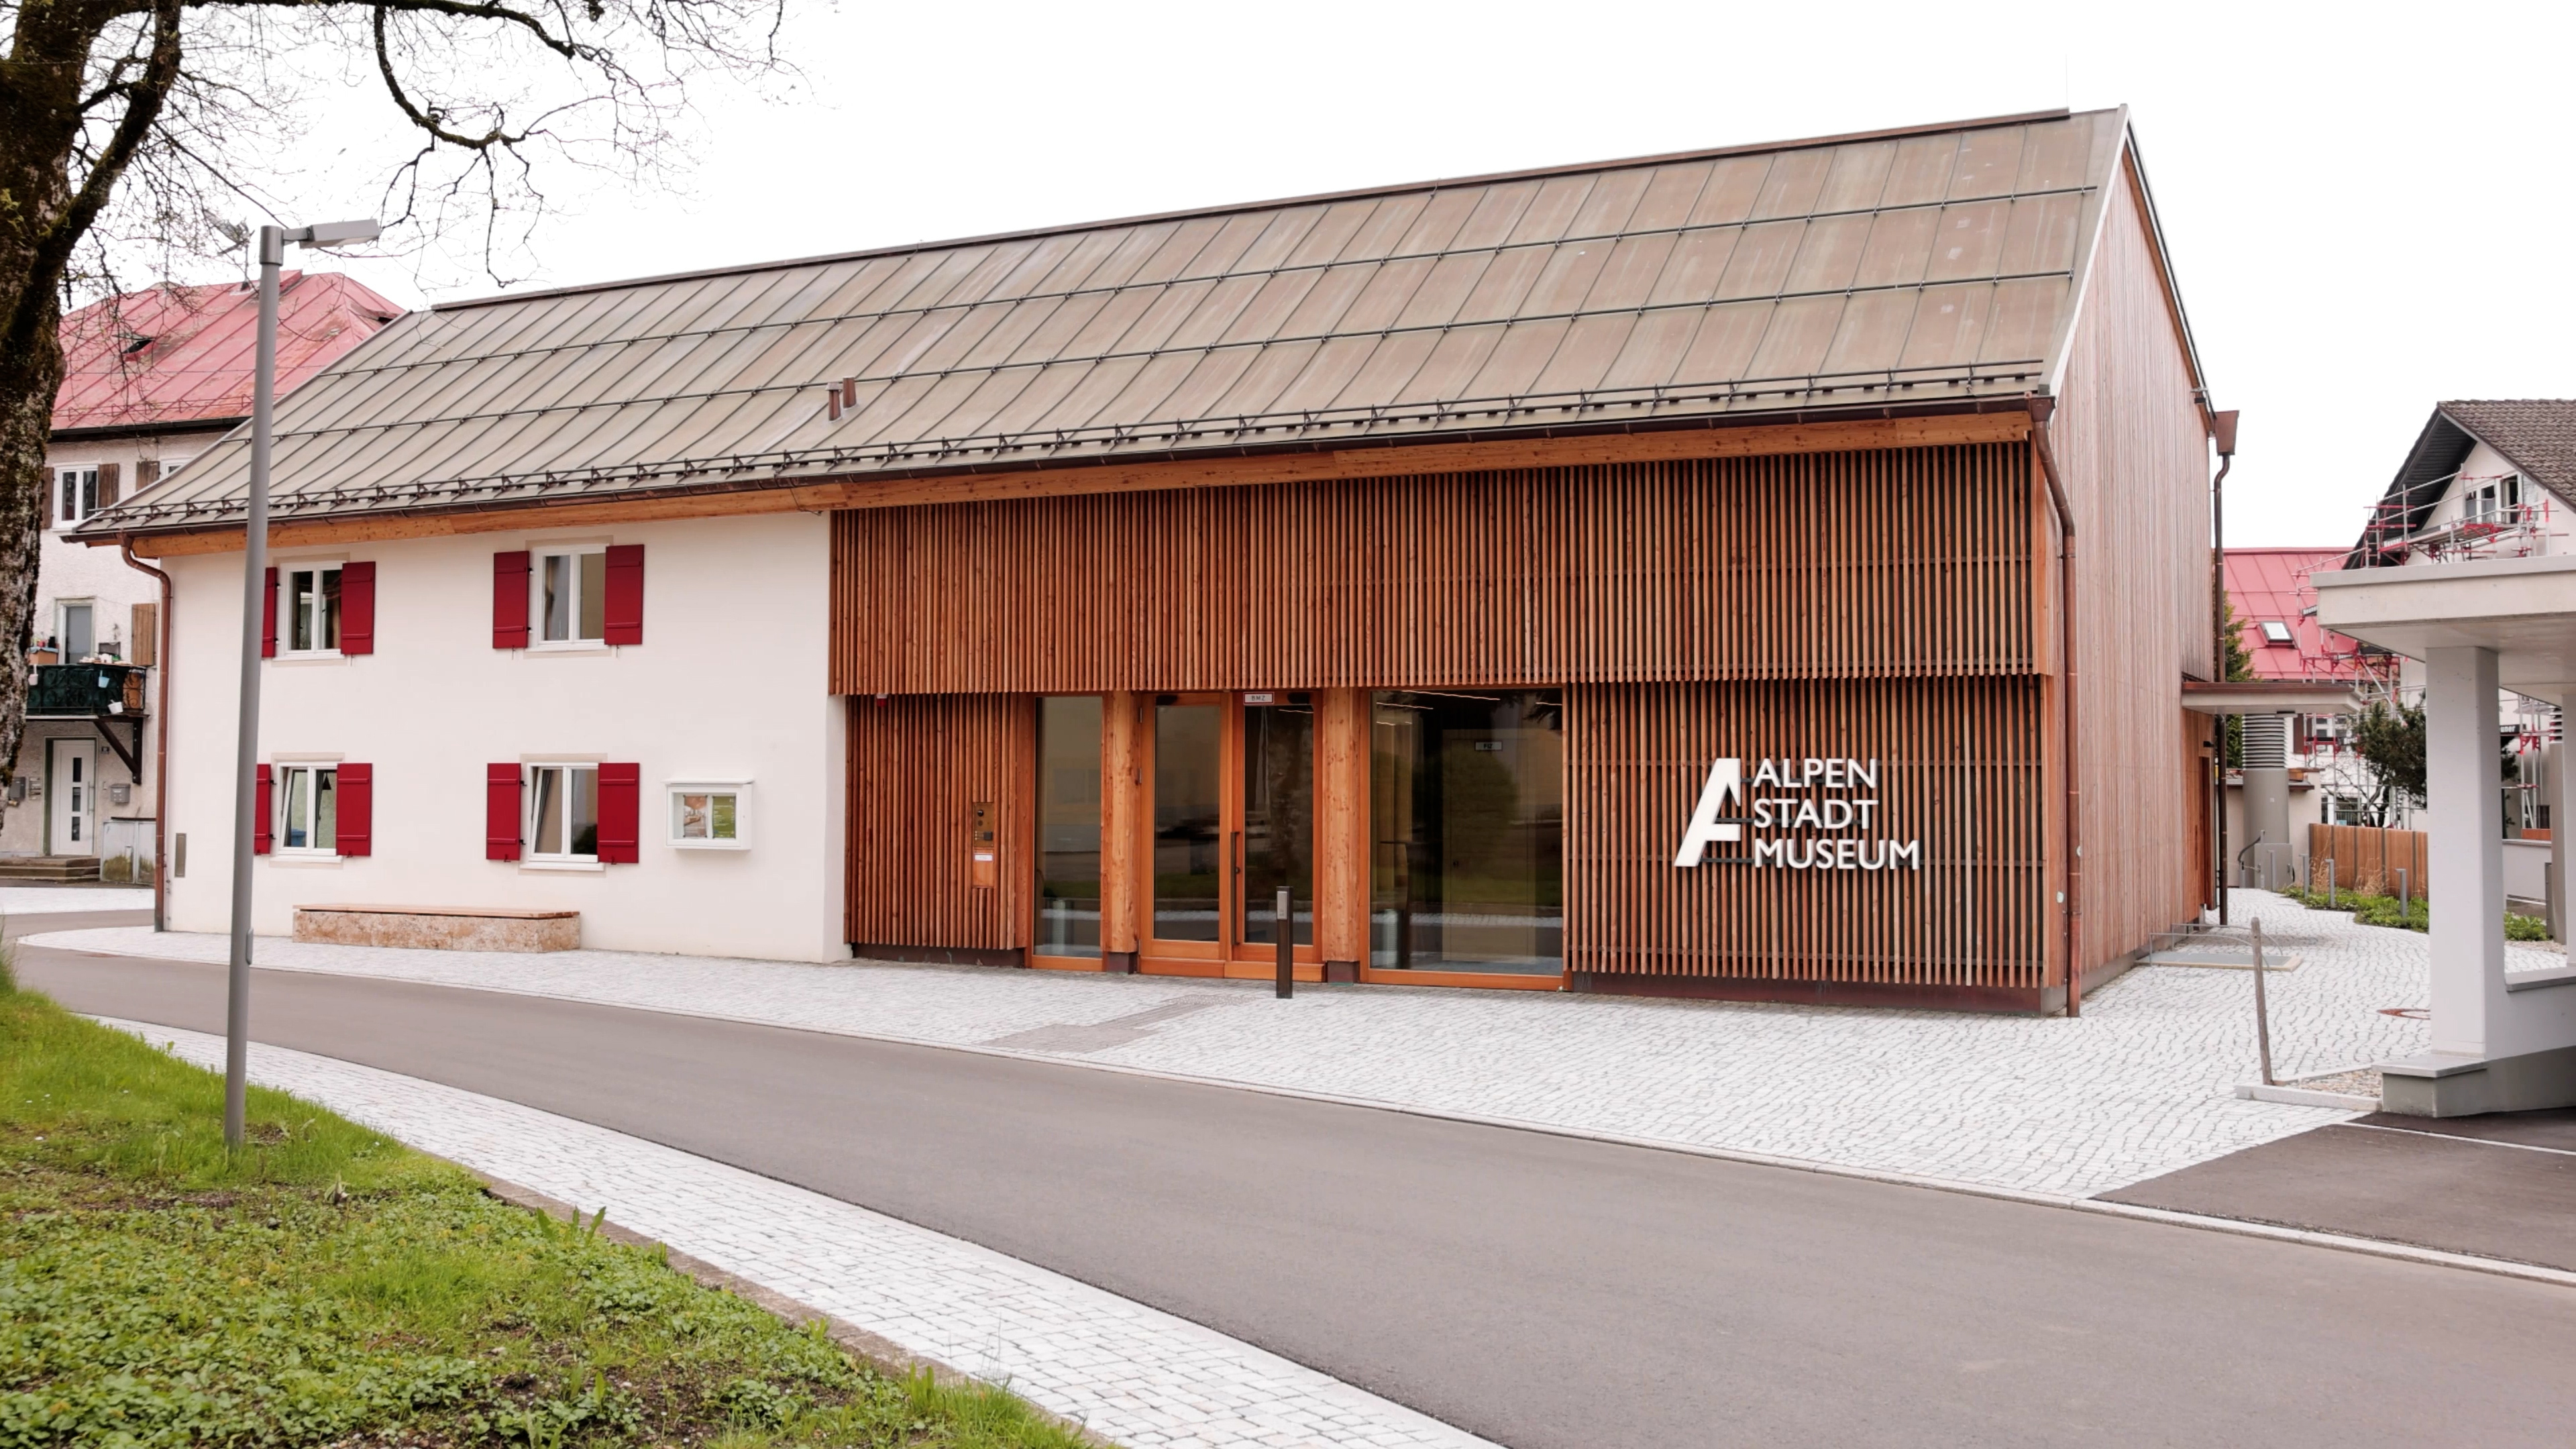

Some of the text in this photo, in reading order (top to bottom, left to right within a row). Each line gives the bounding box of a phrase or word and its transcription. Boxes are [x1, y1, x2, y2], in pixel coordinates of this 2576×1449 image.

[1753, 758, 1877, 788] ALPEN
[1753, 798, 1879, 829] STADT
[1754, 839, 1919, 870] MUSEUM
